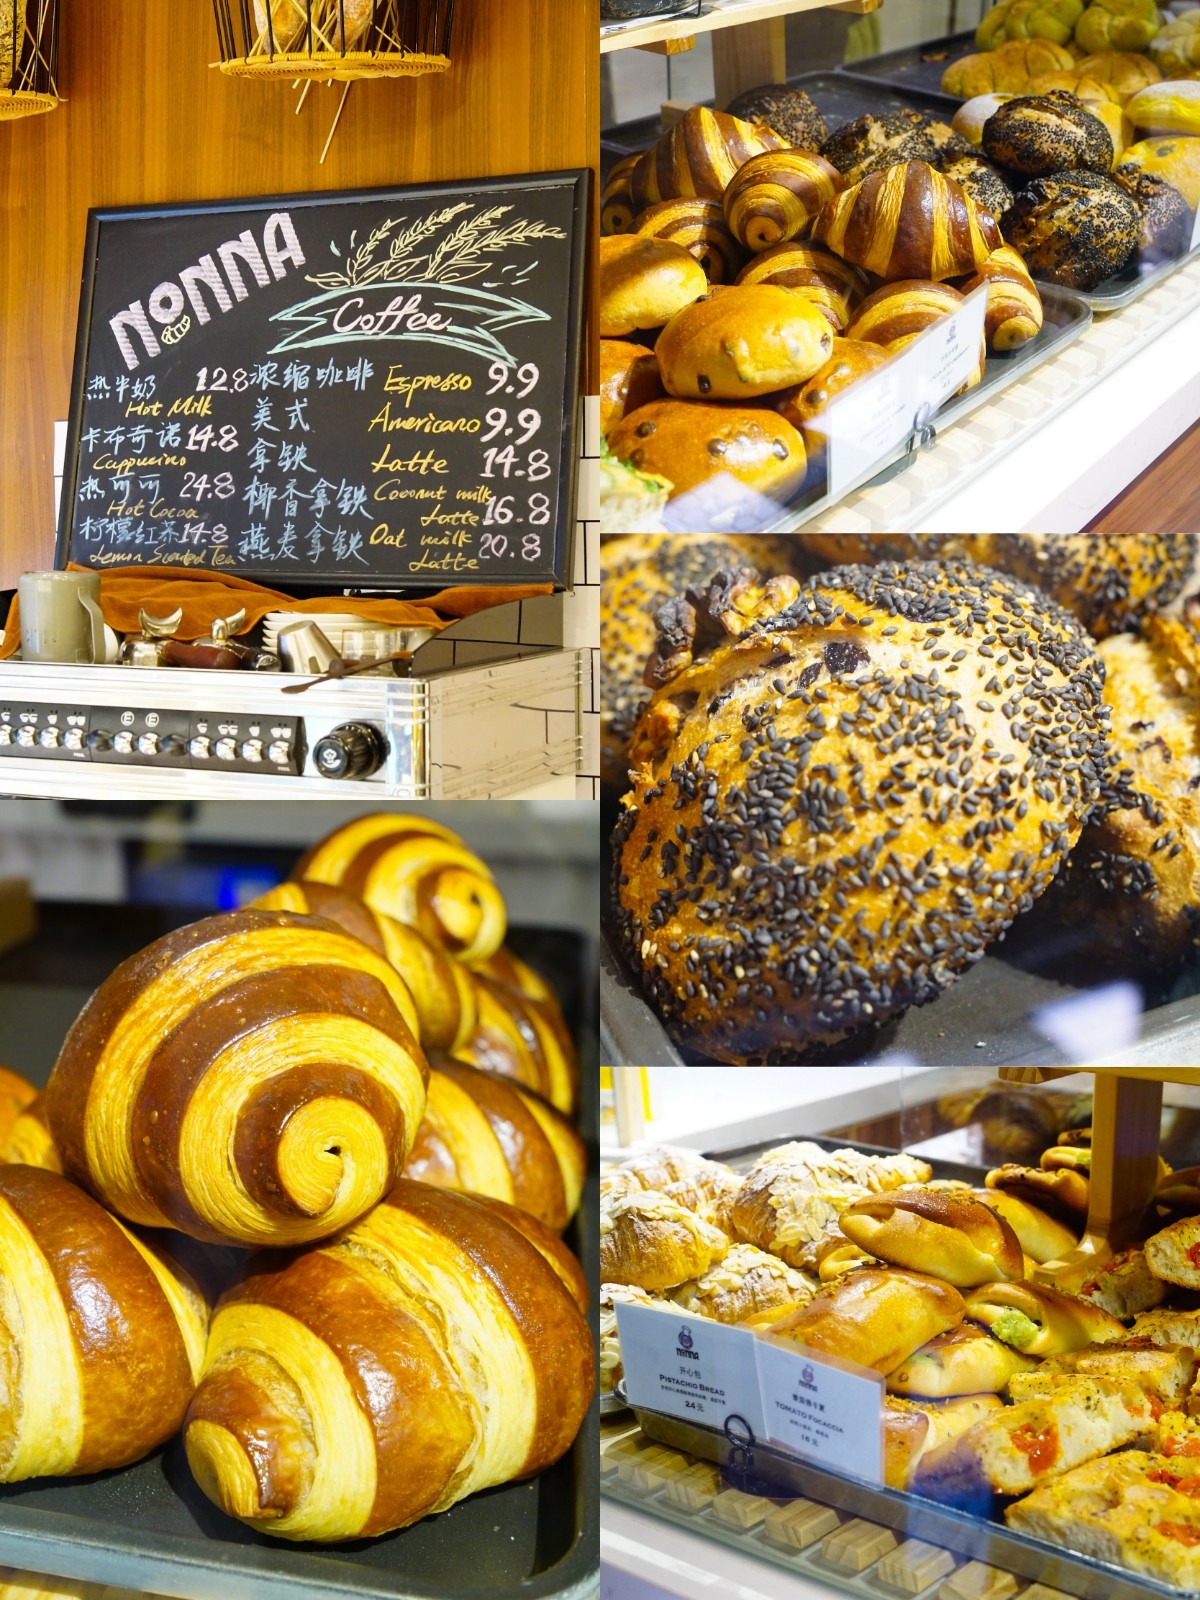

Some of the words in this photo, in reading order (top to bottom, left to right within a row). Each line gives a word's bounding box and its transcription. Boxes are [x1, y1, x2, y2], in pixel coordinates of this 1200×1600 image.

[109, 212, 306, 371] NONNA
[332, 294, 452, 336] Coffee
[86, 374, 156, 403] 热牛奶
[196, 367, 249, 393] 12.8
[249, 356, 374, 392] 浓缩咖啡
[384, 365, 472, 408] Espresso
[485, 361, 540, 399] 9.9
[125, 401, 161, 418] Hot
[167, 395, 213, 418] Milk
[251, 396, 310, 432] 美式
[368, 402, 481, 434] Americano
[480, 407, 542, 445] 9.9
[81, 422, 181, 455] 卡布奇诺
[185, 424, 239, 452] 14.8
[247, 437, 318, 474] 拿铁
[371, 443, 449, 475] Latte
[477, 445, 551, 482] 14.8
[79, 472, 161, 504] 热可可
[180, 472, 235, 502] 24.8
[242, 475, 374, 520] 椰香拿铁
[455, 484, 493, 504] milk
[106, 499, 145, 517] Hot
[149, 497, 200, 519] Cocoa
[421, 503, 480, 527] Latte
[482, 492, 550, 526] 16.8
[79, 515, 180, 544] 柠檬红茶
[178, 521, 229, 545] 14.8
[237, 520, 370, 566] 燕麦拿铁
[369, 523, 408, 548] Oat
[420, 530, 472, 548] milk
[90, 544, 143, 564] Lemon
[207, 545, 237, 567] Tea
[409, 548, 480, 571] Latte
[478, 532, 541, 561] 20.8
[685, 1400, 696, 1409] 24
[698, 1380, 725, 1396] BREAD
[775, 1401, 807, 1419] TOMATO
